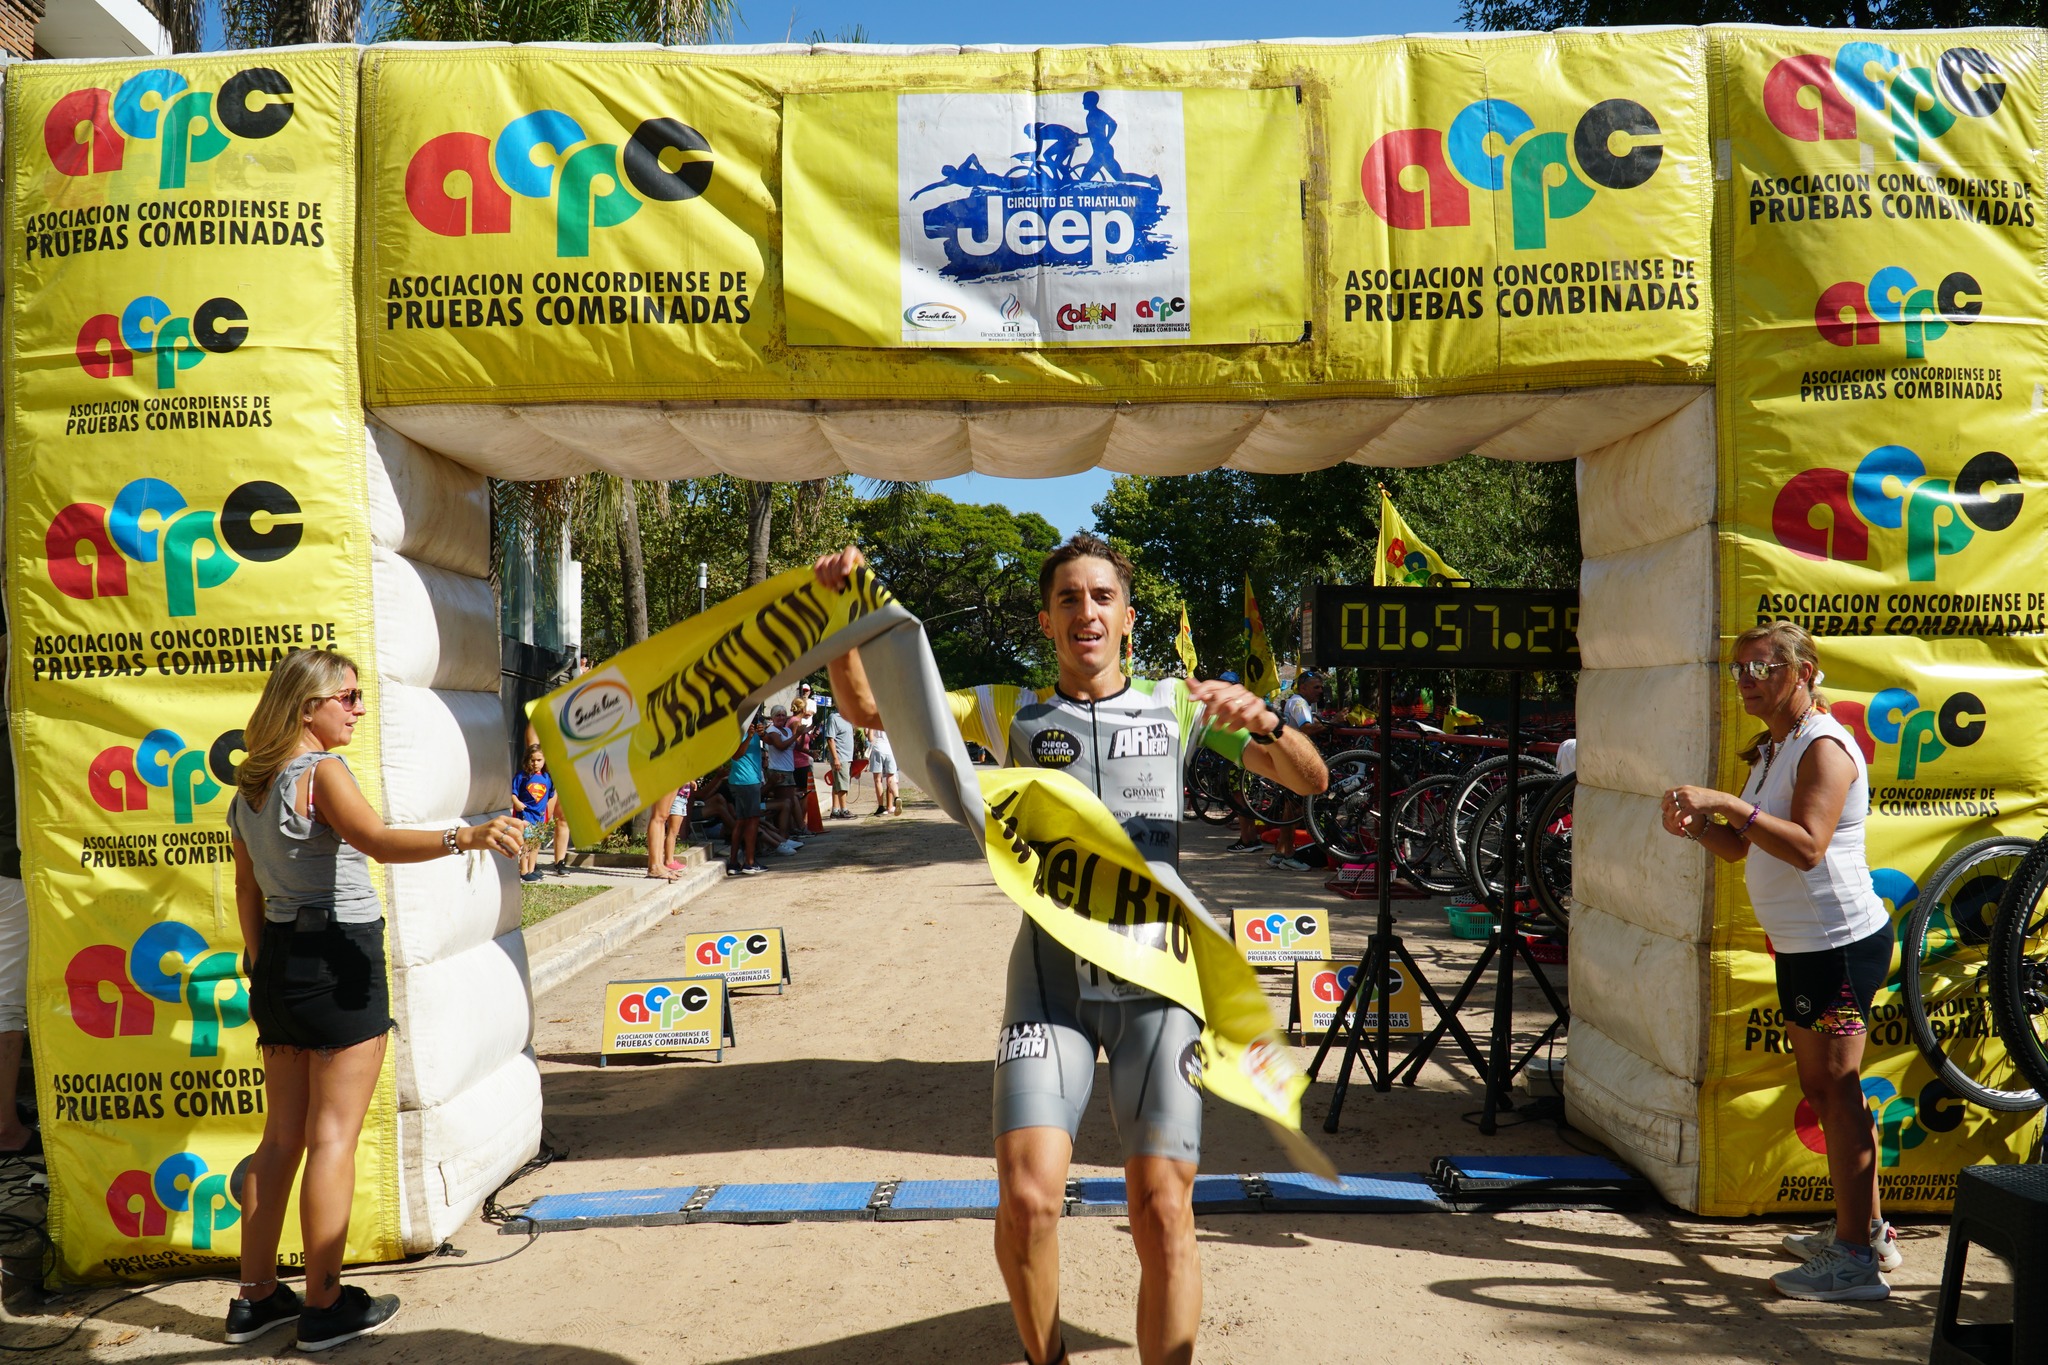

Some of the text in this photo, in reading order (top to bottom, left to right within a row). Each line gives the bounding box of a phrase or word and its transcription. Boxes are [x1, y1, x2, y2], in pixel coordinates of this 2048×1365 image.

[1763, 41, 2006, 162] acpc
[44, 68, 294, 189] acpc
[405, 110, 714, 257] acpc
[1361, 98, 1664, 250] acpc
[1751, 174, 2031, 200] ASOCIACION CONCORDIENSE DE
[26, 200, 322, 233] ASOCIACION CONCORDIENSE DE
[1007, 196, 1136, 208] CIRCUITO DE TRIATHLON
[1750, 194, 2034, 227] PRUEBAS COMBINADAS
[26, 221, 325, 260] PRUEBAS COMBINADAS
[957, 195, 1134, 270] Jeep
[388, 272, 746, 299] ASOCIACION CONCORDIENSE DE
[1345, 259, 1695, 291] ASOCIACION CONCORDIENSE DE
[387, 295, 750, 329] PRUEBAS COMBINADAS
[1136, 296, 1185, 321] acpc
[1345, 283, 1699, 322] PRUEBAS COMBINADAS
[1815, 266, 1982, 358] acpc
[75, 296, 249, 389] acpc
[1801, 368, 2001, 385] ASOCIACION CONCORDIENSE DE
[1801, 381, 2002, 402] PRUEBAS COMBINADAS
[65, 410, 273, 435] PRUEBAS COMBINADAS
[69, 396, 270, 418] ASOCIACION CONCORDIENSE DE
[1772, 445, 2024, 582] acpc
[45, 477, 303, 617] acpc
[1757, 593, 2045, 613] ASOCIACION CONCORDIENSE DE
[33, 623, 335, 655] ASOCIACION CONCORDIENSE DE
[1886, 613, 2046, 636] COMBINADAS
[33, 643, 338, 681] PRUEBAS COMBINA
[1114, 726, 1149, 757] AR
[1148, 738, 1168, 755] TEAM
[1123, 788, 1165, 799] GROMET
[1879, 800, 2000, 817] COMBINADAS
[1880, 788, 1976, 800] CONCORDIENSE
[1980, 788, 1996, 800] DE
[83, 831, 230, 850] ASOCIACION CONCORDI
[81, 845, 235, 868] PRUEBAS COMBIN
[1247, 914, 1316, 947] acpc
[696, 934, 768, 969] acpc
[65, 921, 250, 1057] acp
[726, 974, 770, 982] COMBINADAS
[619, 987, 708, 1028] acpc
[655, 1037, 709, 1045] COMBINADAS
[1007, 1037, 1046, 1060] TEAM
[54, 1068, 265, 1094] ASOCIACION CONCORD
[56, 1089, 264, 1121] PRUEBAS COMBI
[1777, 1187, 1835, 1201] PRUEB
[1781, 1175, 1833, 1187] ASOCIA
